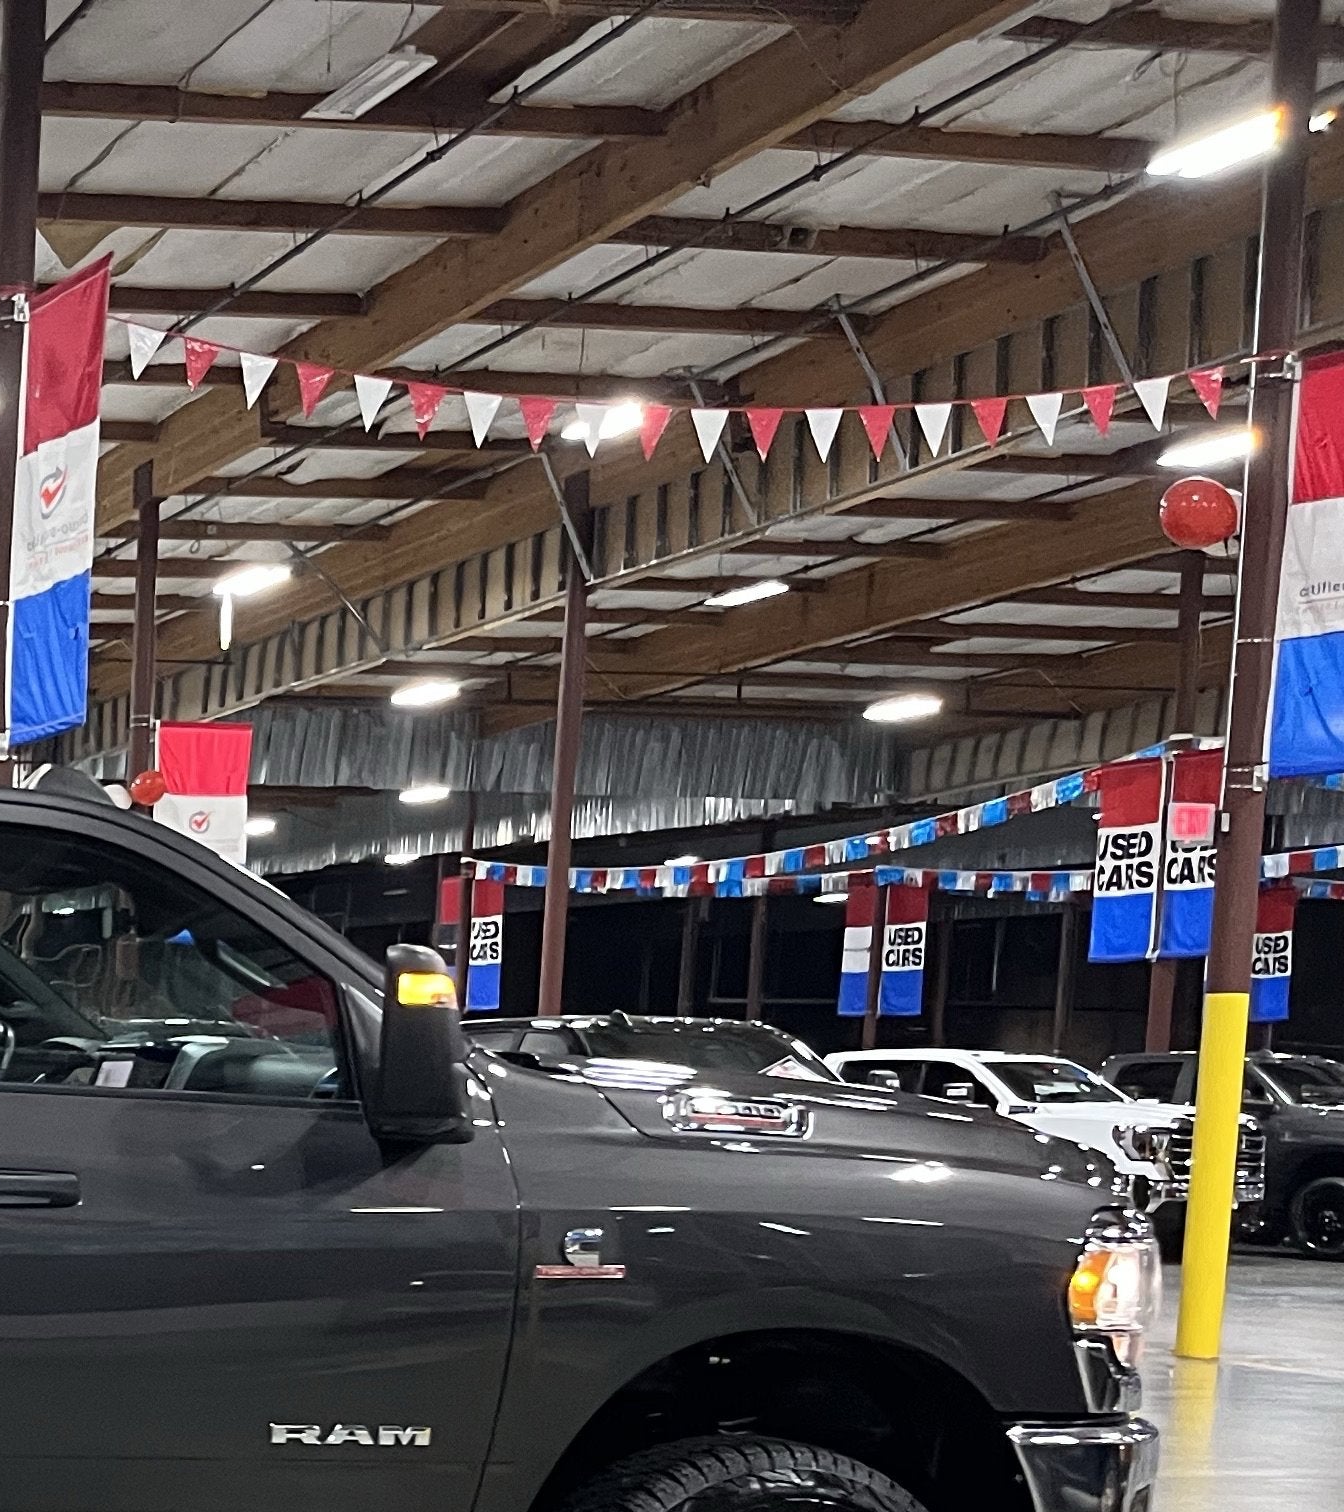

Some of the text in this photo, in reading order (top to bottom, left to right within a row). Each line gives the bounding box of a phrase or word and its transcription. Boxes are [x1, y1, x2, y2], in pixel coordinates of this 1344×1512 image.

[1097, 830, 1154, 861] USED
[1097, 860, 1154, 892] CARS
[472, 921, 500, 940] UED
[471, 941, 500, 961] CAS
[269, 1423, 431, 1446] RAM
